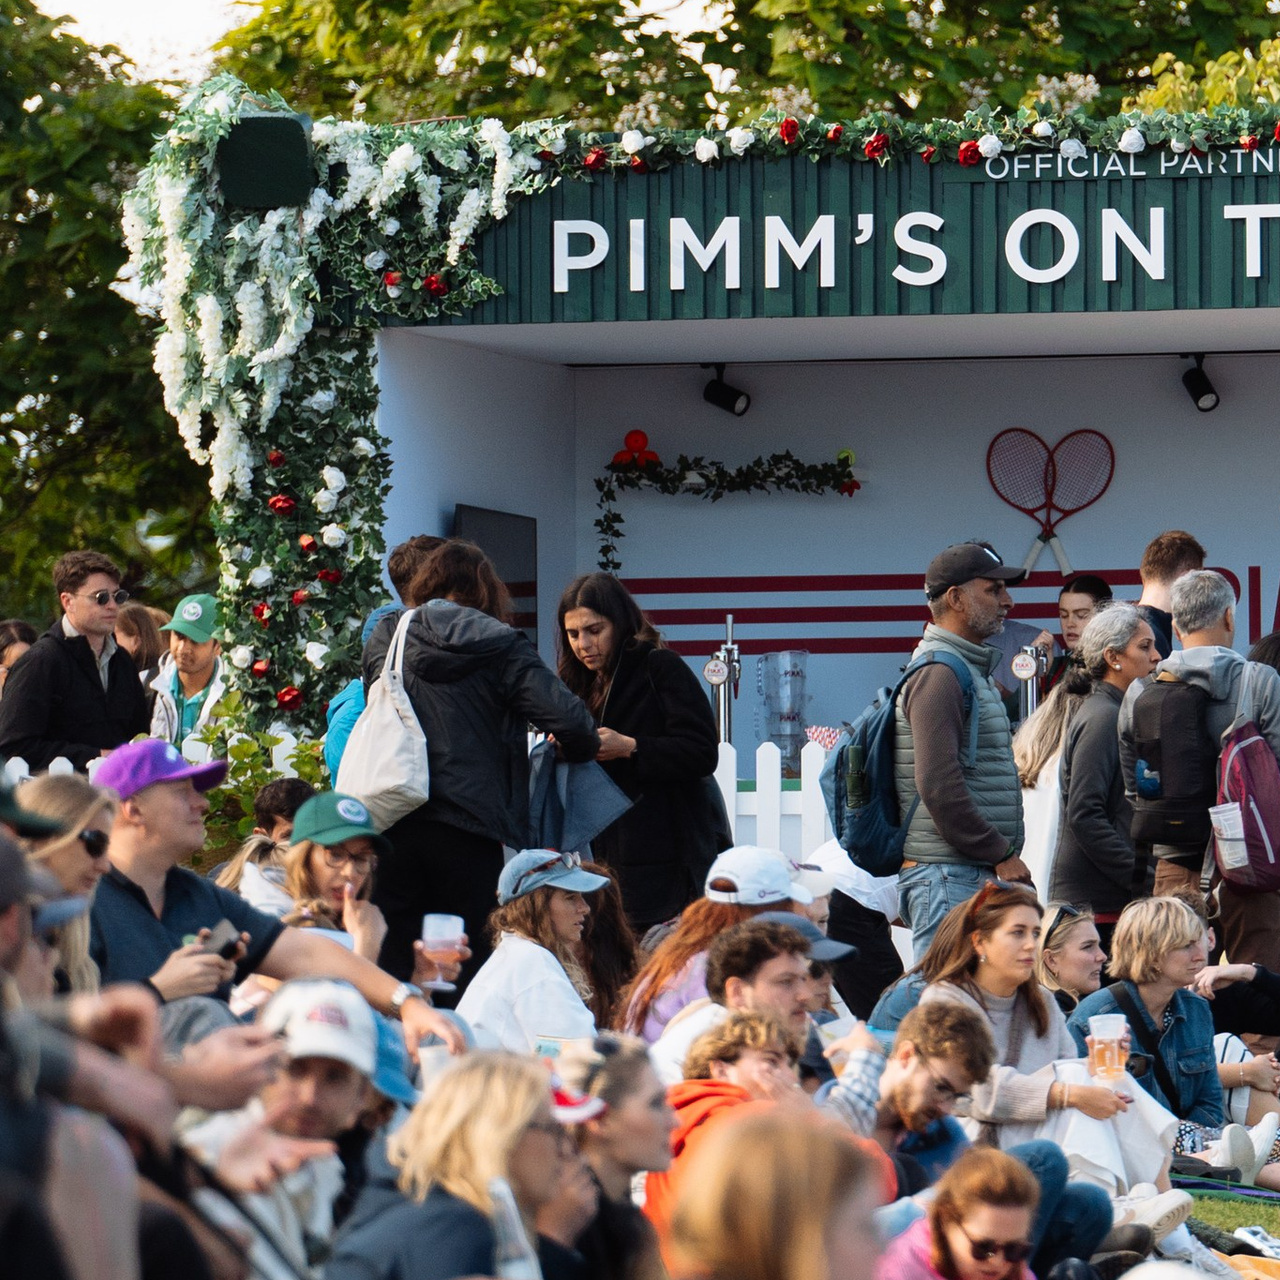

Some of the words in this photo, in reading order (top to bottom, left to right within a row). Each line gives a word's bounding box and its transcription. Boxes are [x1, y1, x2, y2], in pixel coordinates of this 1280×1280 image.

[984, 151, 1147, 179] OFFICIAL
[553, 210, 948, 293] PIMM'S
[1004, 207, 1165, 283] ON
